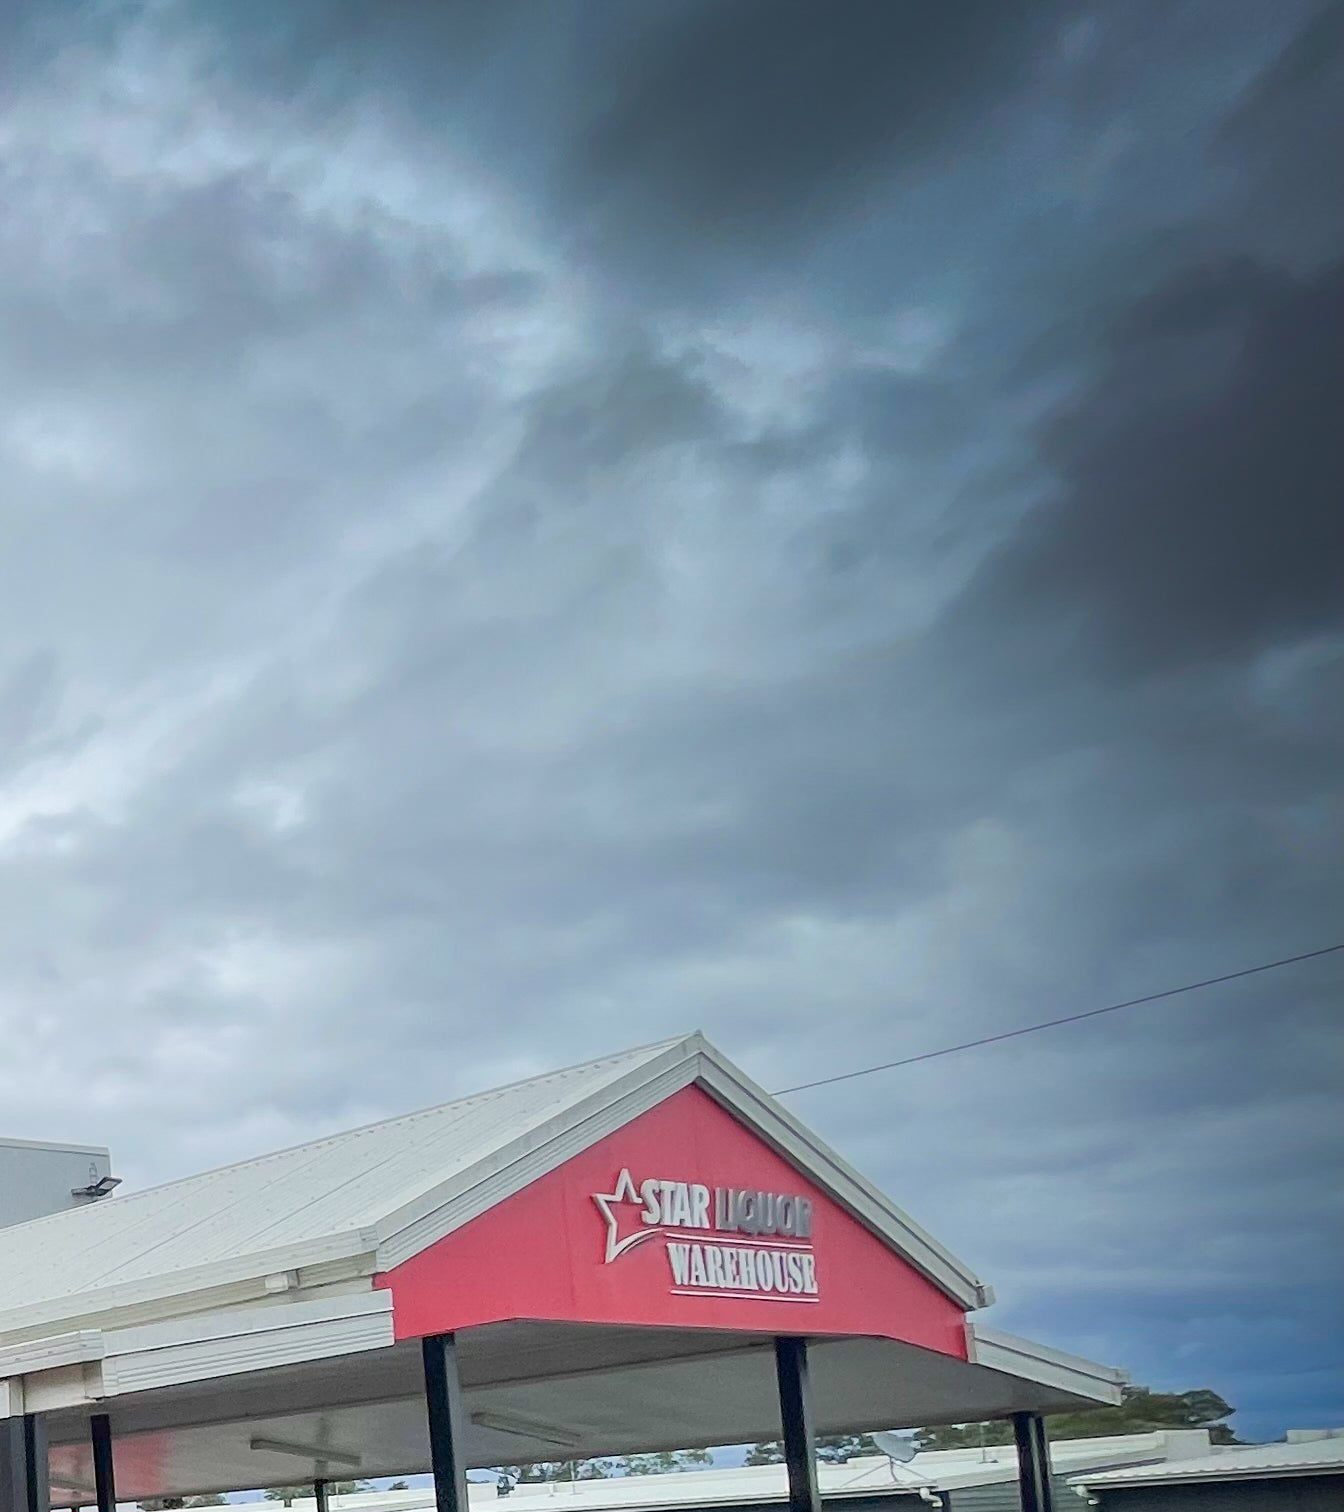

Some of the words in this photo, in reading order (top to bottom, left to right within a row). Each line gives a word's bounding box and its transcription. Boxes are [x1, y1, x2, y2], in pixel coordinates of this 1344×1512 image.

[640, 1179, 711, 1230] STAR
[714, 1187, 812, 1238] LIQUOR
[666, 1242, 818, 1294] WAREHOUSE
